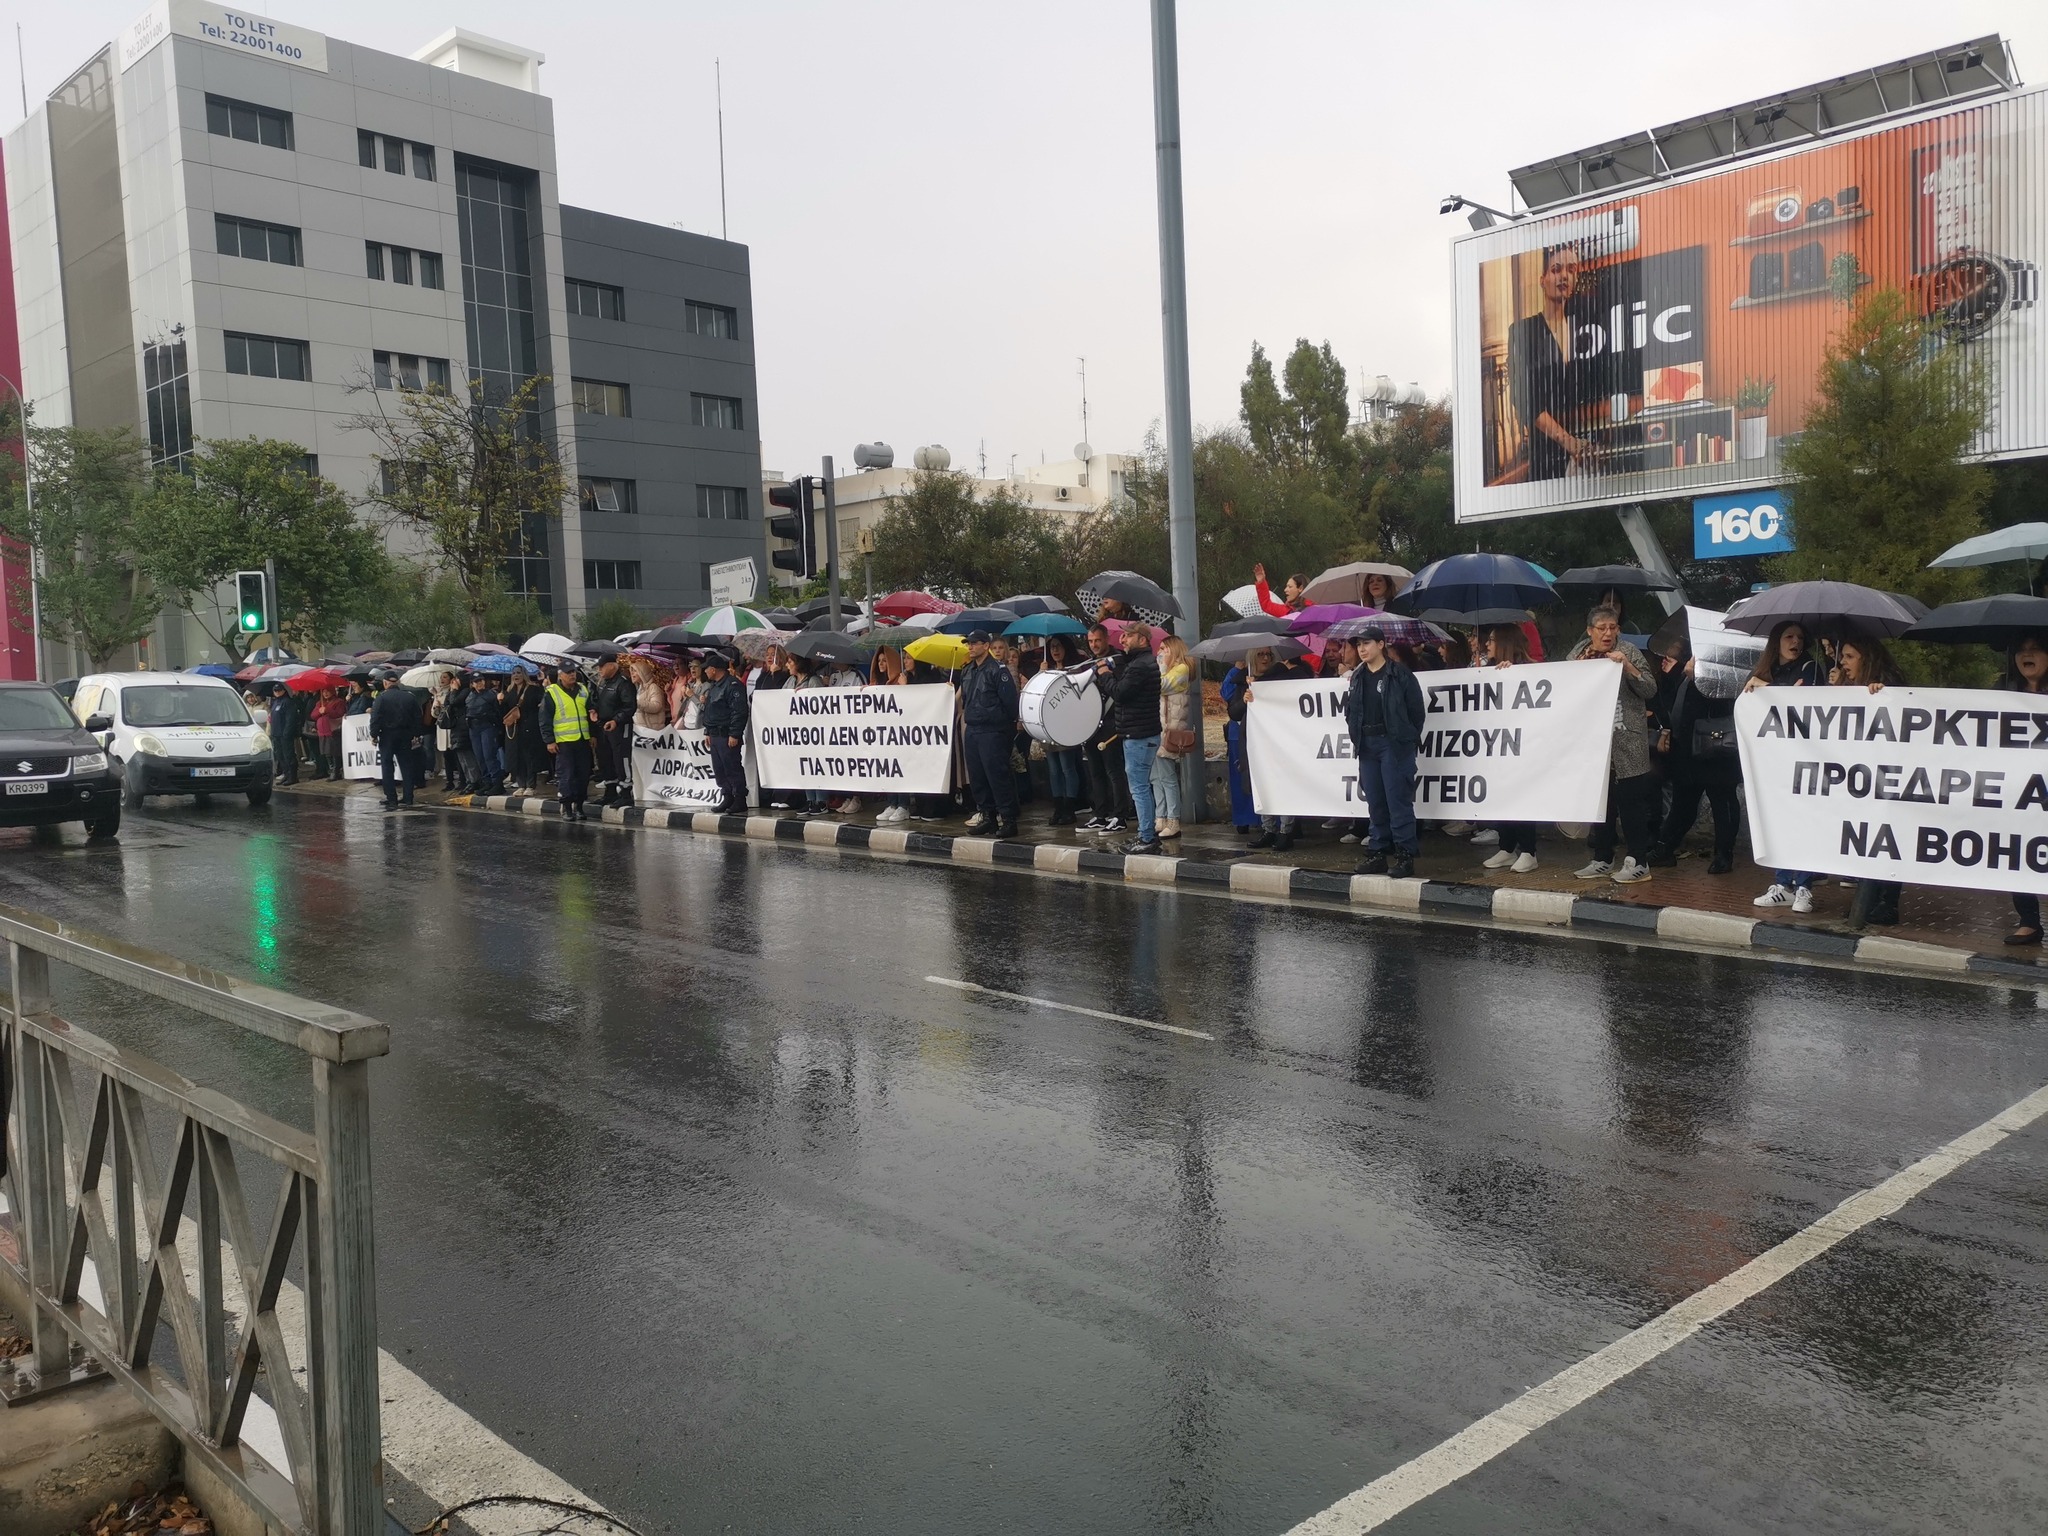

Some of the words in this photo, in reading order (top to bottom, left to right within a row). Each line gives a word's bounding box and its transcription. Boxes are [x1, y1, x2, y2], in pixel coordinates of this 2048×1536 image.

[134, 22, 142, 37] TO
[142, 13, 152, 31] LET
[225, 13, 245, 29] TO
[250, 19, 275, 37] LET
[199, 21, 226, 40] Tel:
[230, 30, 302, 59] 22001400
[789, 695, 841, 716] ΑΝΟΧΗ
[844, 693, 904, 717] ΤΕΡΜΑ,
[1298, 691, 1323, 718] ΟΙ
[1427, 681, 1504, 713] ΣΤΗΝ
[1511, 679, 1553, 710] Α2
[762, 727, 774, 746] ΟΙ
[777, 727, 825, 746] ΜΙΣΘΟΙ
[829, 726, 859, 746] ΔΕΝ
[862, 725, 949, 746] ΦΤΑΝΟΥΝ
[1316, 733, 1358, 760] ΔΕ
[799, 757, 825, 776] ΓΙΑ
[825, 757, 845, 777] ΤΟ
[847, 758, 904, 778] ΡΕΥΜΑ
[8, 783, 46, 793] KRQ399
[1792, 760, 2006, 809] ΠΡΟΕΔΡΕ
[1840, 820, 1902, 861] ΝΑ
